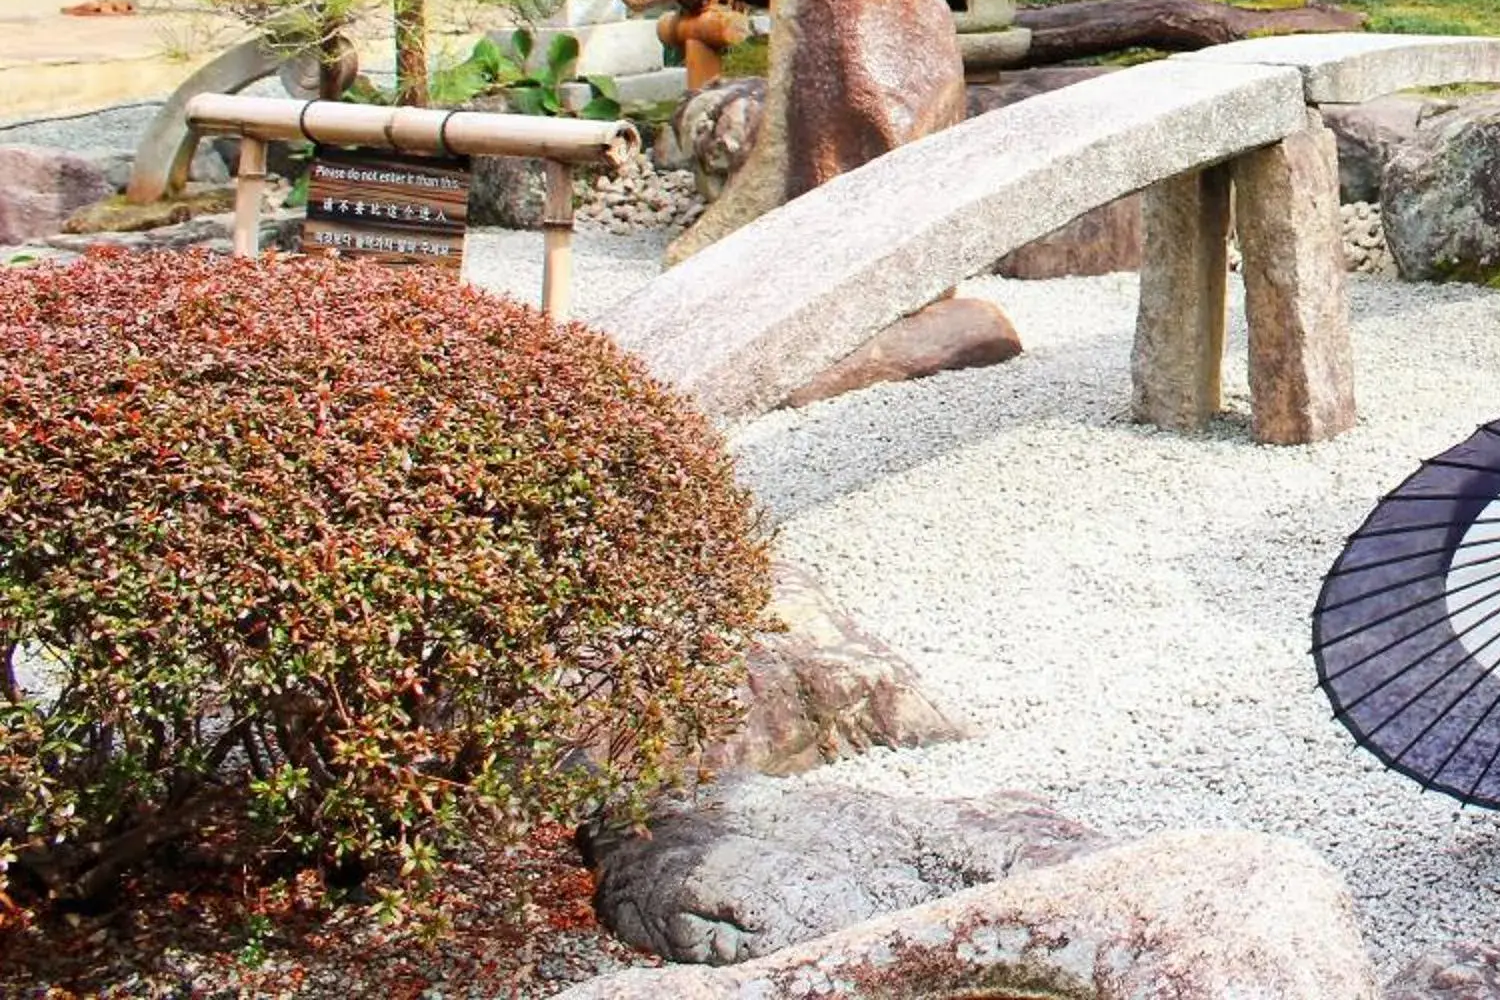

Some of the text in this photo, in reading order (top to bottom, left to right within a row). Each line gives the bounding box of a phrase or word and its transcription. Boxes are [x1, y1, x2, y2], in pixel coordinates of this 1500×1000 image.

[315, 165, 346, 180] Please
[347, 168, 360, 181] do
[361, 170, 377, 182] not
[379, 171, 406, 185] enter
[416, 174, 439, 188] than
